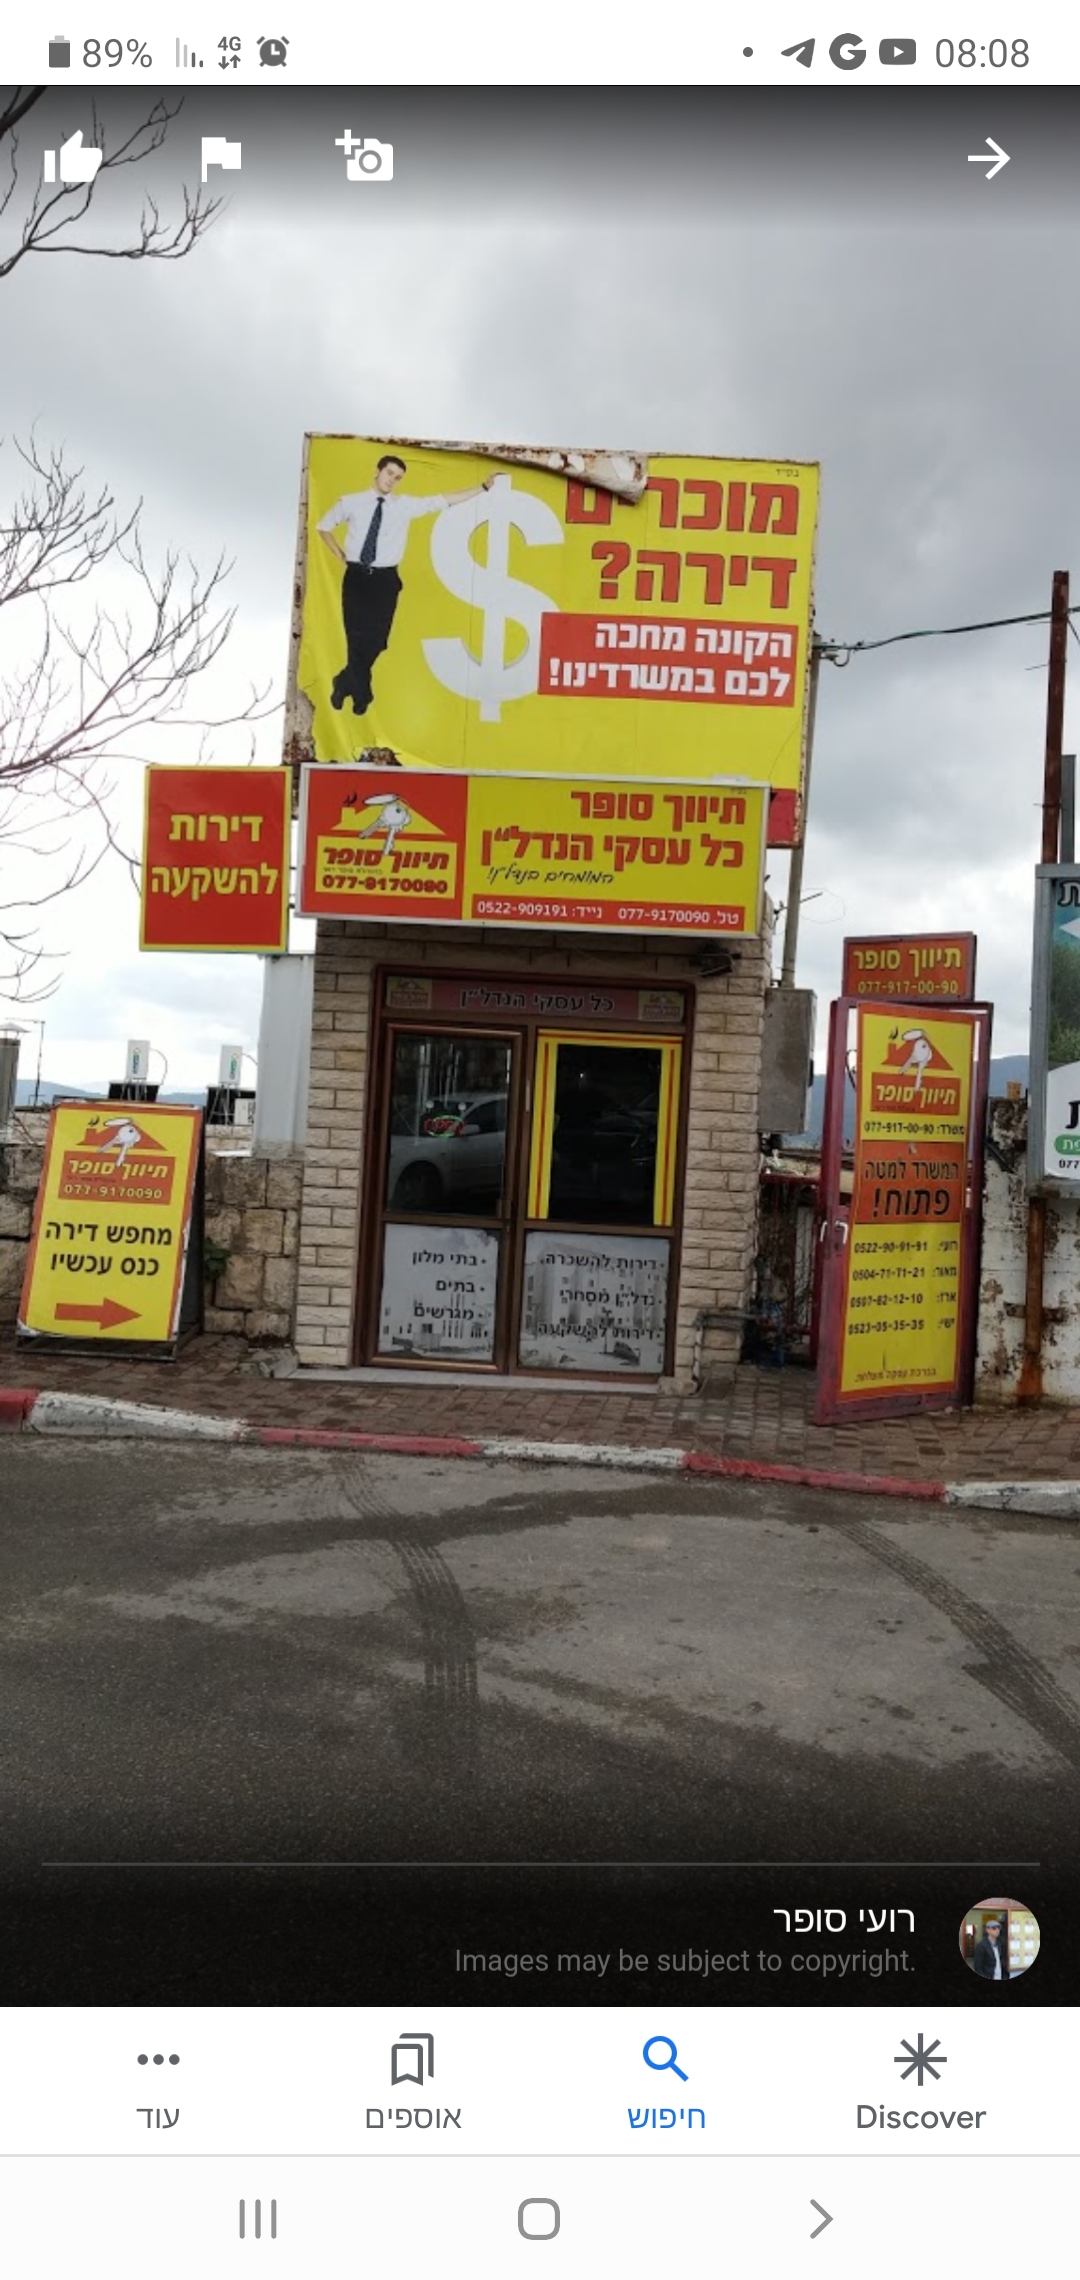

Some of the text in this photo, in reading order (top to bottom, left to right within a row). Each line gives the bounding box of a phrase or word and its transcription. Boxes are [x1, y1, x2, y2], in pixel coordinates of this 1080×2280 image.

[565, 477, 800, 536] מוכרם
[591, 541, 797, 609] דירה?
[596, 622, 792, 664] הקונה מחכה
[549, 658, 790, 698] לכם במשרדינו!
[571, 791, 746, 832] תיווך סופר
[169, 814, 263, 842] דירות
[323, 847, 450, 873] תיווך סופר
[481, 825, 744, 872] כל עסקי הנדל"ן
[152, 862, 279, 901] להשקעה
[322, 875, 448, 894] 077-9170090
[477, 901, 740, 925] טל. 077-9170090 נייד: 0522-909191
[853, 948, 962, 977] תיווך סופר
[857, 981, 959, 994] 077-917-00-90
[534, 994, 583, 1012] עסקי
[591, 993, 615, 1011] כל
[876, 1084, 956, 1108] תיווך סופר
[69, 1160, 115, 1174] סופר
[122, 1163, 168, 1180] תיווך
[865, 1158, 959, 1181] המשרד למטה
[873, 1188, 951, 1218] פתוח!
[45, 1222, 173, 1246] מחפש דירה
[50, 1253, 159, 1276] כנס עכשיו
[412, 1249, 477, 1266] בתי מלון
[616, 1258, 657, 1270] דירות
[436, 1280, 475, 1292] בתים
[560, 1290, 609, 1303] מסחרי
[414, 1306, 475, 1320] מגרשים
[613, 1327, 655, 1340] דירות
